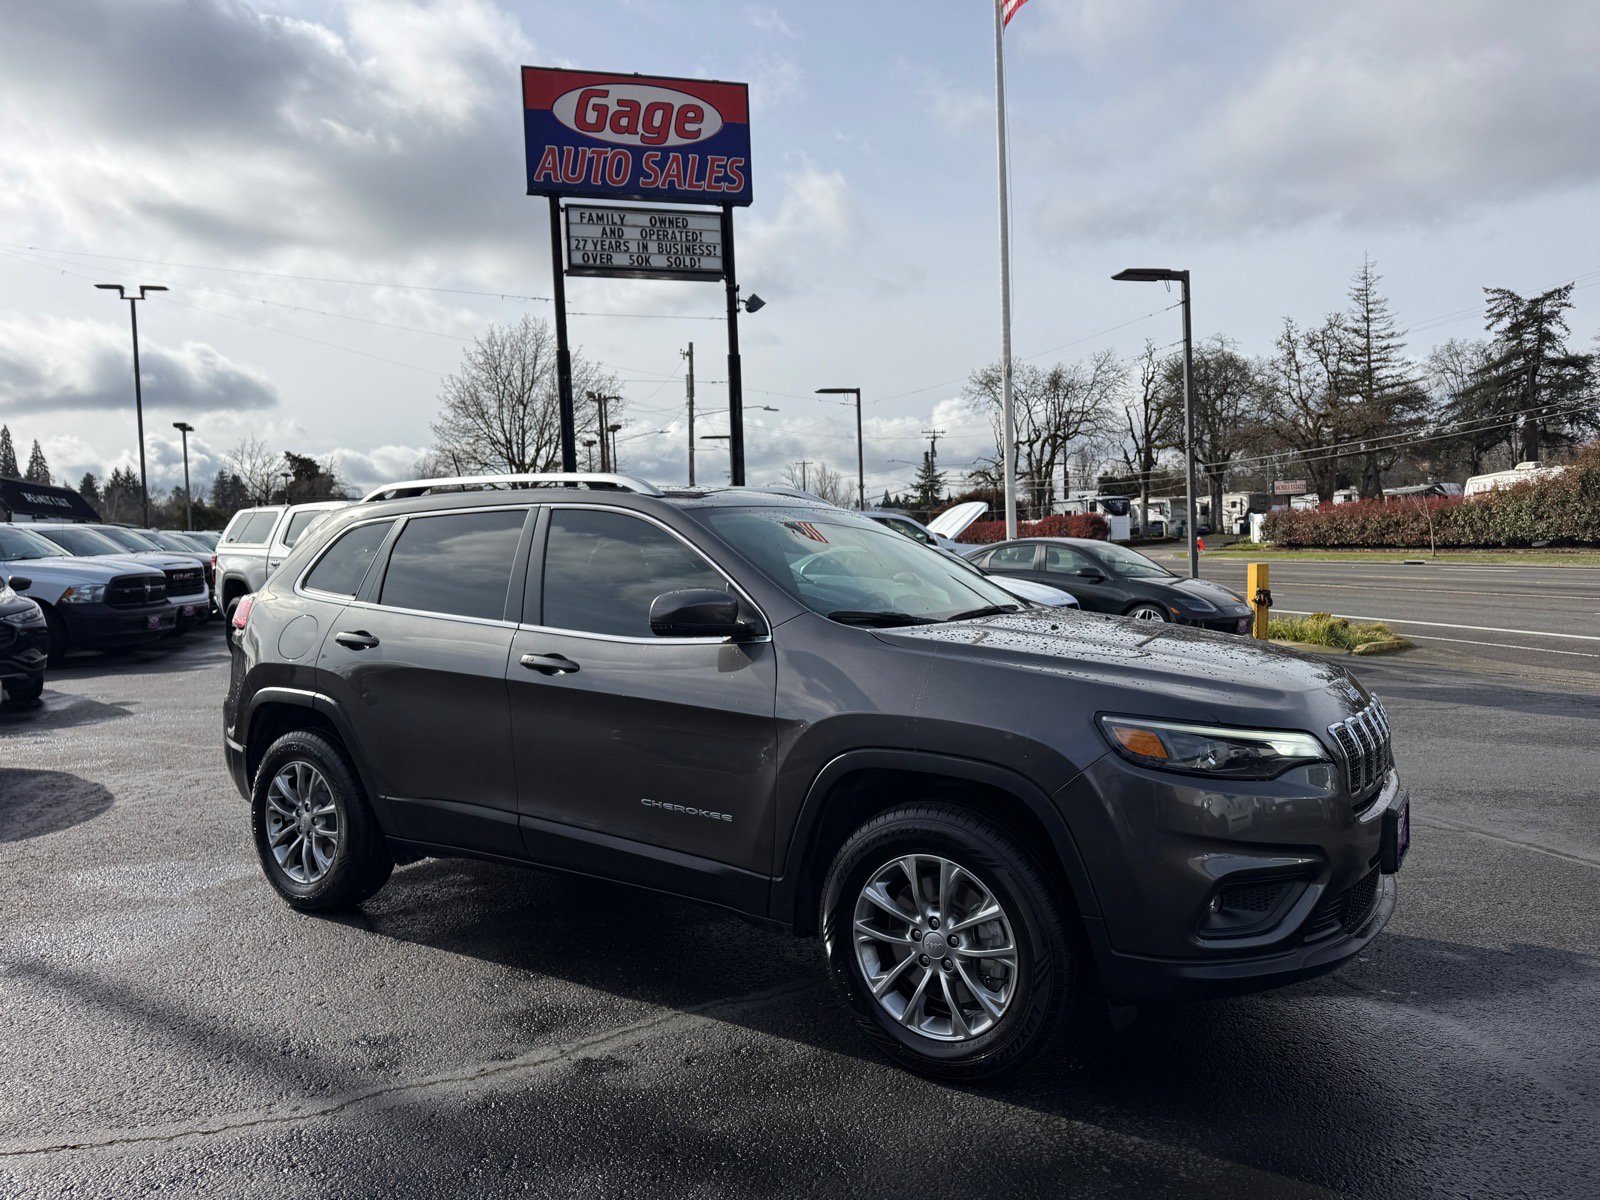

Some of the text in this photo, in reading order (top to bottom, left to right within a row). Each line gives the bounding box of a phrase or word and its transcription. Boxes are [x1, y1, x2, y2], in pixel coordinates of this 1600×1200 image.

[574, 88, 705, 146] Gage
[533, 145, 745, 193] AUTO SALES
[579, 211, 689, 228] FAMILY OWNED
[601, 226, 703, 242] AND OPERATED!
[574, 238, 717, 256] 27 YEARS IN BUSINESS!
[582, 252, 702, 269] OVER 50K SOLD!
[172, 572, 194, 581] GMC
[640, 797, 733, 823] CHEROKEE
